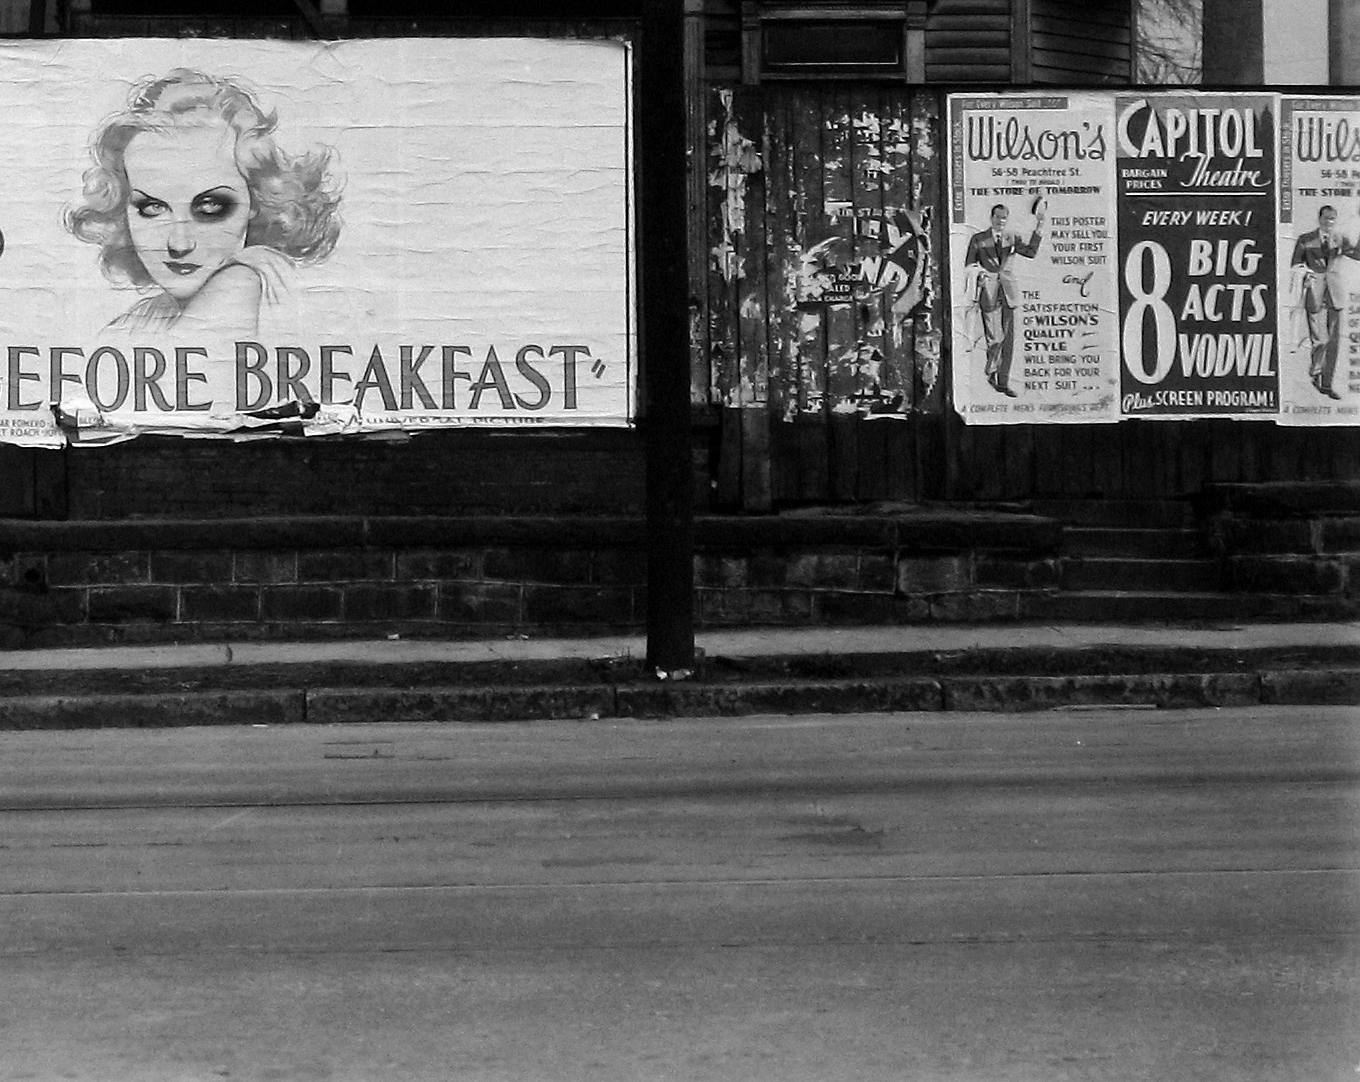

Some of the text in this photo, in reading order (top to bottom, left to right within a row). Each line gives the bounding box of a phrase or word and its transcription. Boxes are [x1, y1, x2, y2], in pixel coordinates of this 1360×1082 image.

[1117, 99, 1263, 158] CAPITOL
[968, 116, 1106, 161] Wilson's
[1022, 167, 1066, 176] Peachtree
[1122, 169, 1167, 179] BARGAIN
[1180, 151, 1272, 187] Theatre
[1126, 180, 1163, 189] PRICES
[971, 186, 1101, 196] THE STORE OF TOMORROW
[1298, 187, 1352, 197] THE STORE
[1051, 217, 1106, 226] THIS POSTER
[1142, 211, 1192, 226] EVERY
[1051, 230, 1070, 239] MAY
[1071, 230, 1090, 239] SELL
[1052, 243, 1104, 251] YOUR FIRST
[1050, 255, 1107, 265] WILSON SUIT
[1188, 239, 1263, 277] BIG
[1062, 271, 1094, 297] and
[1022, 291, 1040, 299] THE
[1022, 304, 1099, 313] SATISFACTION
[1180, 284, 1268, 323] ACTS
[1123, 241, 1177, 384] 8
[1023, 313, 1099, 326] OF WILSON'S
[1023, 329, 1075, 341] QUALITY
[1024, 342, 1067, 351] STYLE
[1024, 355, 1100, 364] WILL BRING YOU
[1178, 333, 1276, 377] VODVIL
[235, 341, 607, 411] BREAKFAST"
[1024, 368, 1100, 377] BACK FOR YOUR
[1024, 381, 1077, 390] NEXT SUIT
[1122, 392, 1156, 413] Plus
[1155, 390, 1203, 406] SCREEN
[1207, 390, 1274, 406] PROGRAM!
[10, 428, 39, 437] ROACH
